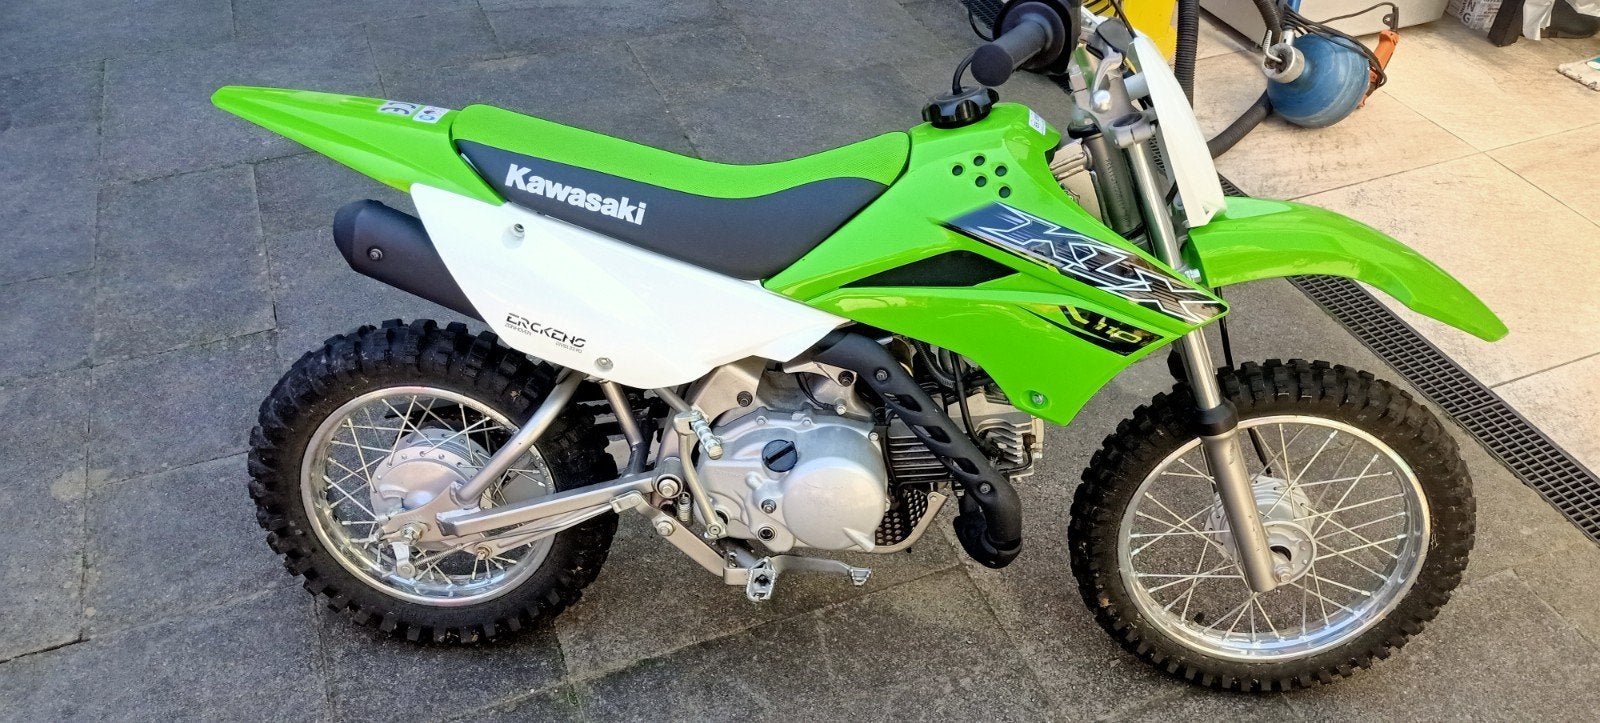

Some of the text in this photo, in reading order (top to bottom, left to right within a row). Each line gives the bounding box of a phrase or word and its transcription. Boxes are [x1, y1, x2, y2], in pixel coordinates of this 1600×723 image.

[505, 163, 647, 226] Kawasaki
[978, 200, 1223, 324] KLX
[506, 312, 587, 348] ERCKENS
